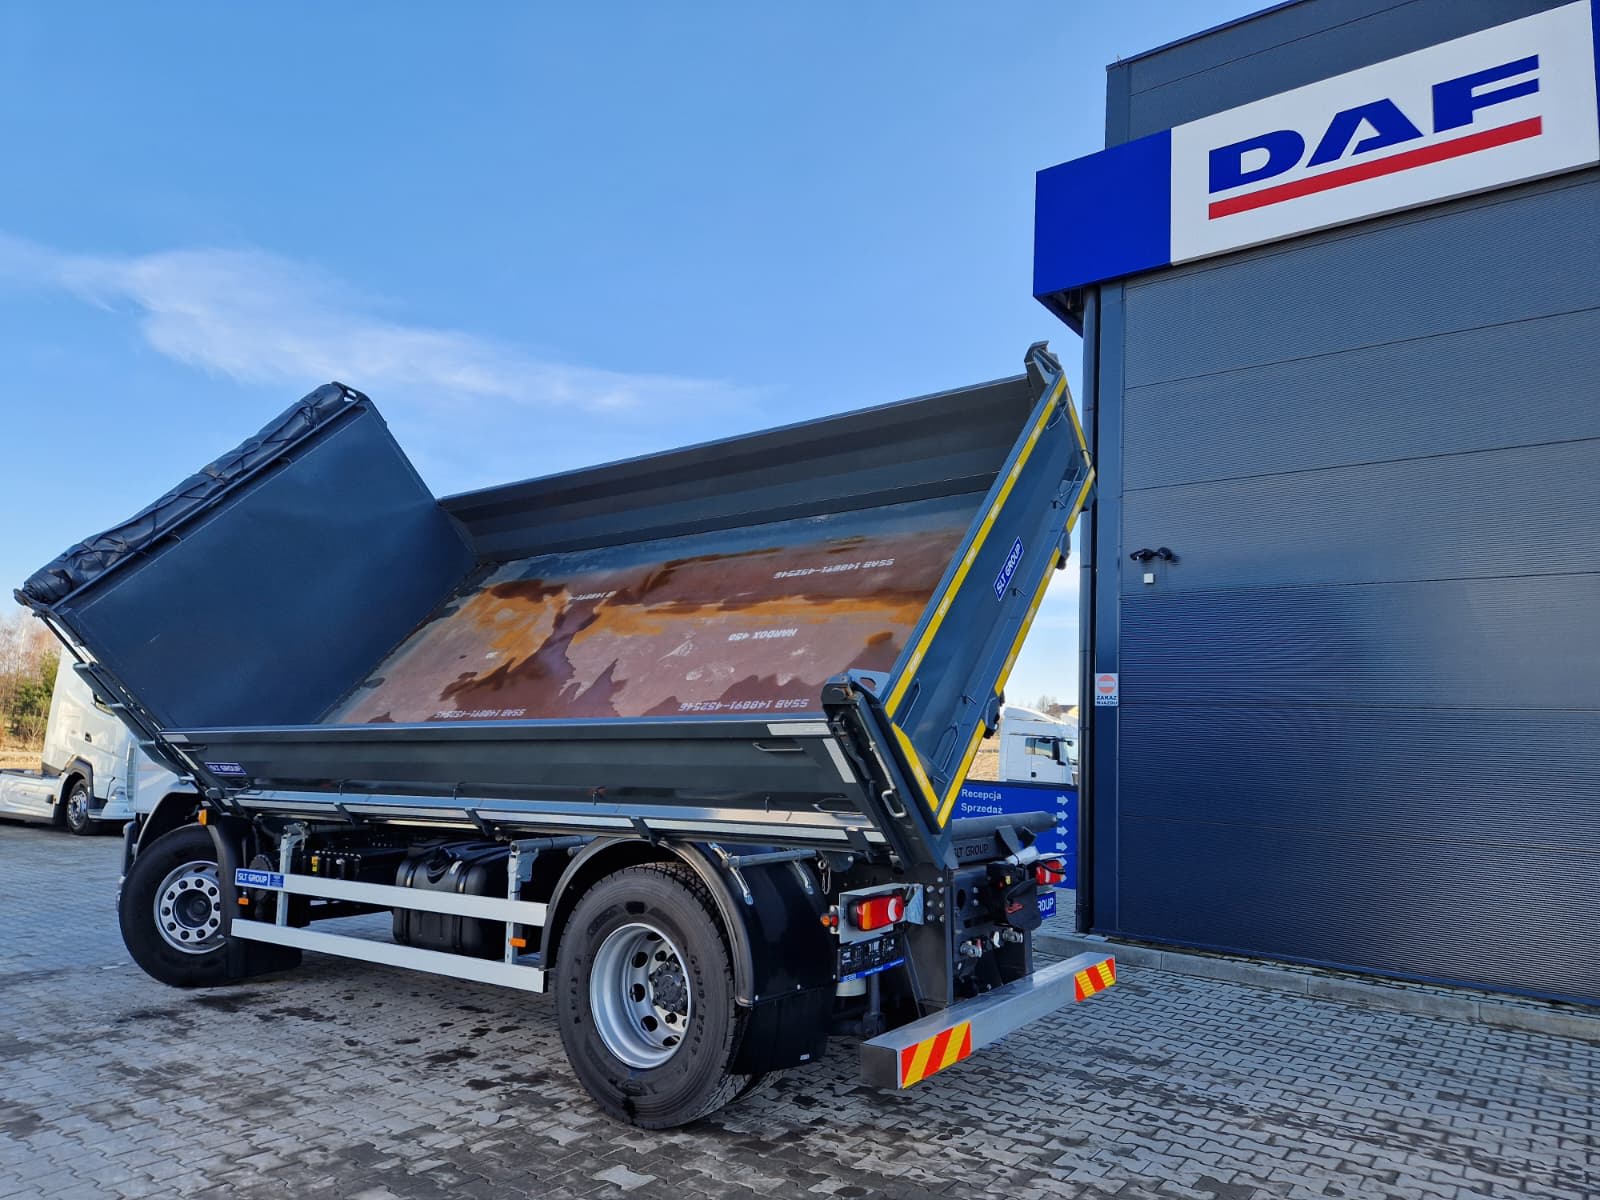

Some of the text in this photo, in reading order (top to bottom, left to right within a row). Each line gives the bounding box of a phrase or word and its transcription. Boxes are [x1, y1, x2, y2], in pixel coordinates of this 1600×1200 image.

[1209, 54, 1540, 194] DAF
[863, 558, 895, 568] SSAB
[996, 543, 1020, 594] SLT GROUP
[752, 628, 798, 640] HARDOX
[775, 698, 810, 709] SSAB
[961, 788, 1002, 802] Recepcja
[966, 843, 989, 857] GROUP
[238, 872, 248, 881] SLT
[248, 874, 267, 883] GROUP
[1037, 897, 1054, 911] ROUP
